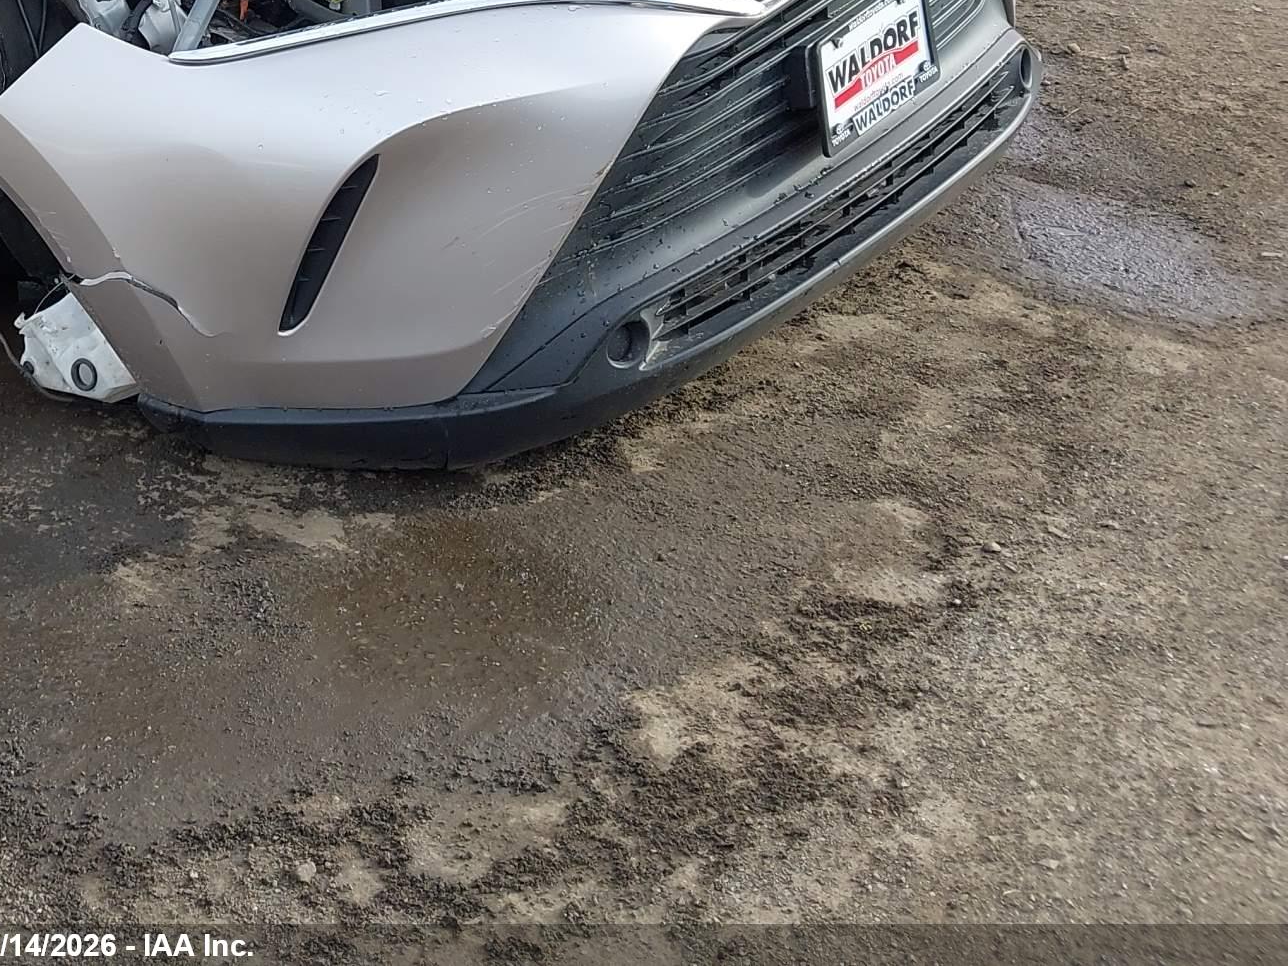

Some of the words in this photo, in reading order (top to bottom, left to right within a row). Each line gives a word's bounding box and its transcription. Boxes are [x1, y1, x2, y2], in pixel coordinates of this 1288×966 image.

[828, 10, 919, 94] WALDORF
[861, 54, 897, 88] TOYOTA
[918, 65, 939, 84] TOYOTA
[854, 80, 915, 132] WALDORF
[831, 127, 852, 147] TOYOTA
